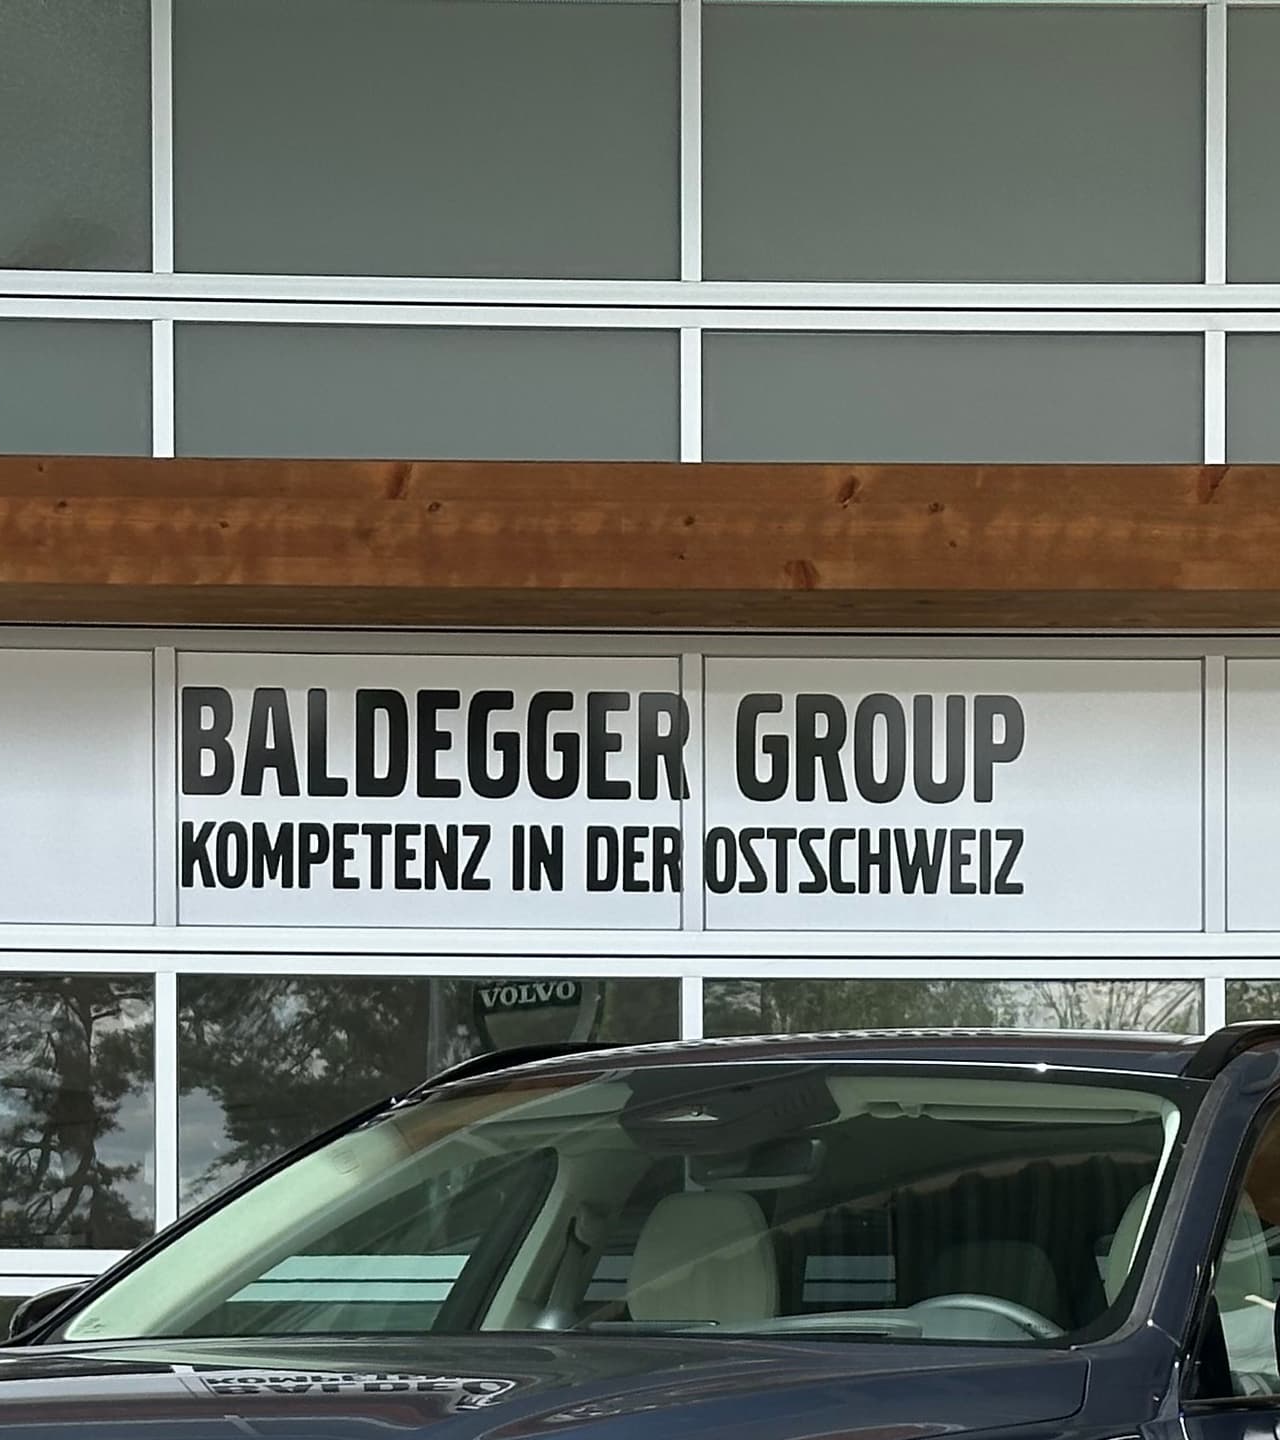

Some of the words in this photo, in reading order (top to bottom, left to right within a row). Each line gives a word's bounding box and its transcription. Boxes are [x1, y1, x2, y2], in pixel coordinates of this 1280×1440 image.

[180, 686, 691, 800] BALDEGGER
[735, 692, 1026, 804] GROUP
[180, 821, 492, 891] KOMPETENZ
[513, 825, 565, 891] IN
[586, 825, 684, 893] DER
[704, 827, 1025, 895] OSTSCHWEIZ
[478, 981, 576, 1009] VOLVO
